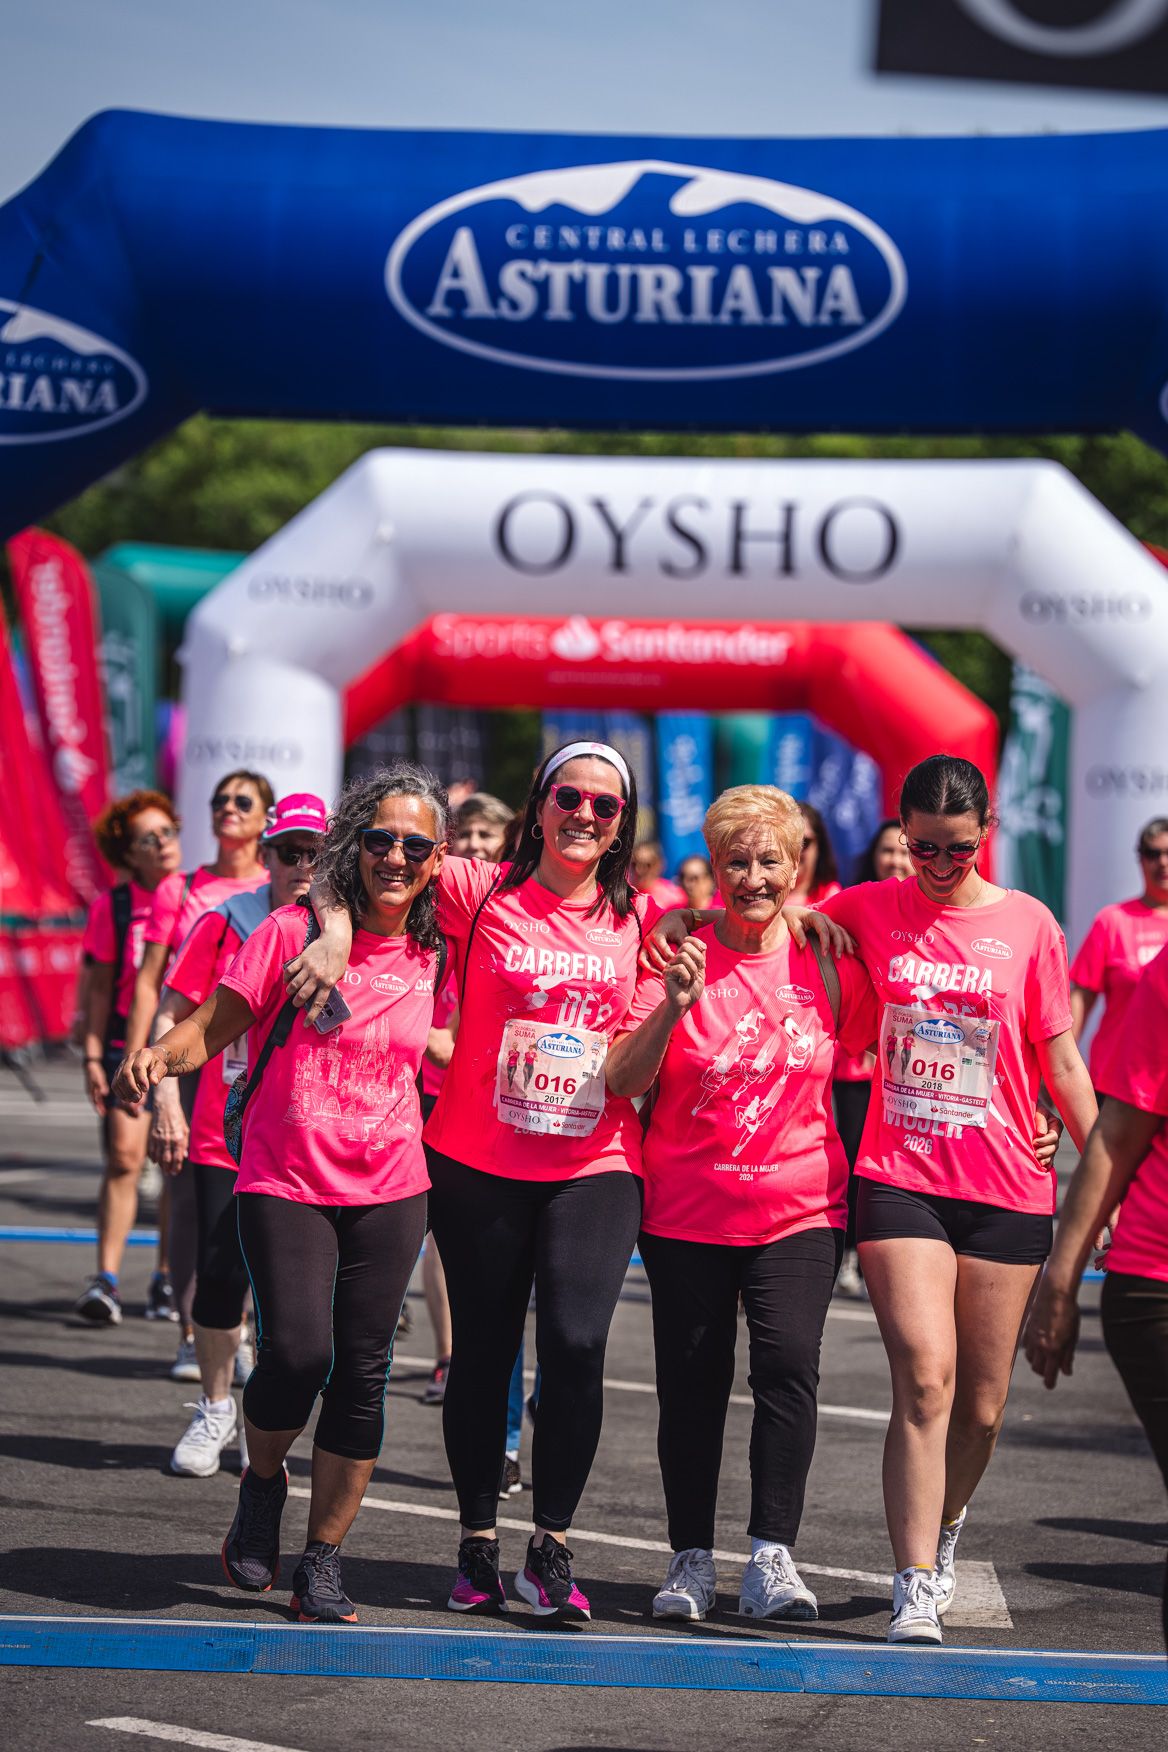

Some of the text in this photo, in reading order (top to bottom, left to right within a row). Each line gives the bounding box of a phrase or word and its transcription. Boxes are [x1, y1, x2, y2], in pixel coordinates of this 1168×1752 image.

[505, 224, 850, 254] CENTRAL LECHERA
[426, 226, 865, 326] ASTURIANA
[0, 371, 119, 413] IANA
[490, 488, 906, 585] OYSHO
[601, 619, 792, 666] Santander
[504, 919, 550, 934] OYSHO
[891, 929, 935, 945] OYSHO
[974, 943, 1009, 957] ASTURIANA
[504, 945, 617, 985] CARRERA
[888, 955, 993, 998] CARRERA
[702, 987, 739, 1000] YSHO
[892, 1015, 913, 1025] SUMA
[513, 1029, 536, 1040] SUMA
[917, 1025, 961, 1040] ASTURIANA
[911, 1059, 955, 1081] 016
[534, 1073, 577, 1095] 016
[921, 1080, 943, 1091] 2018
[544, 1095, 565, 1105] 2017
[887, 1096, 918, 1110] OYSHO
[915, 1090, 934, 1098] MUJER
[938, 1093, 985, 1106] VITORIA-GASTEIZ
[538, 1104, 557, 1113] MUJER
[939, 1107, 974, 1119] Santander
[509, 1110, 540, 1125] OYSHO
[903, 1133, 933, 1155] 2026
[713, 1163, 740, 1172] CARRERA
[759, 1164, 779, 1173] MUJER
[739, 1173, 754, 1181] 2024
